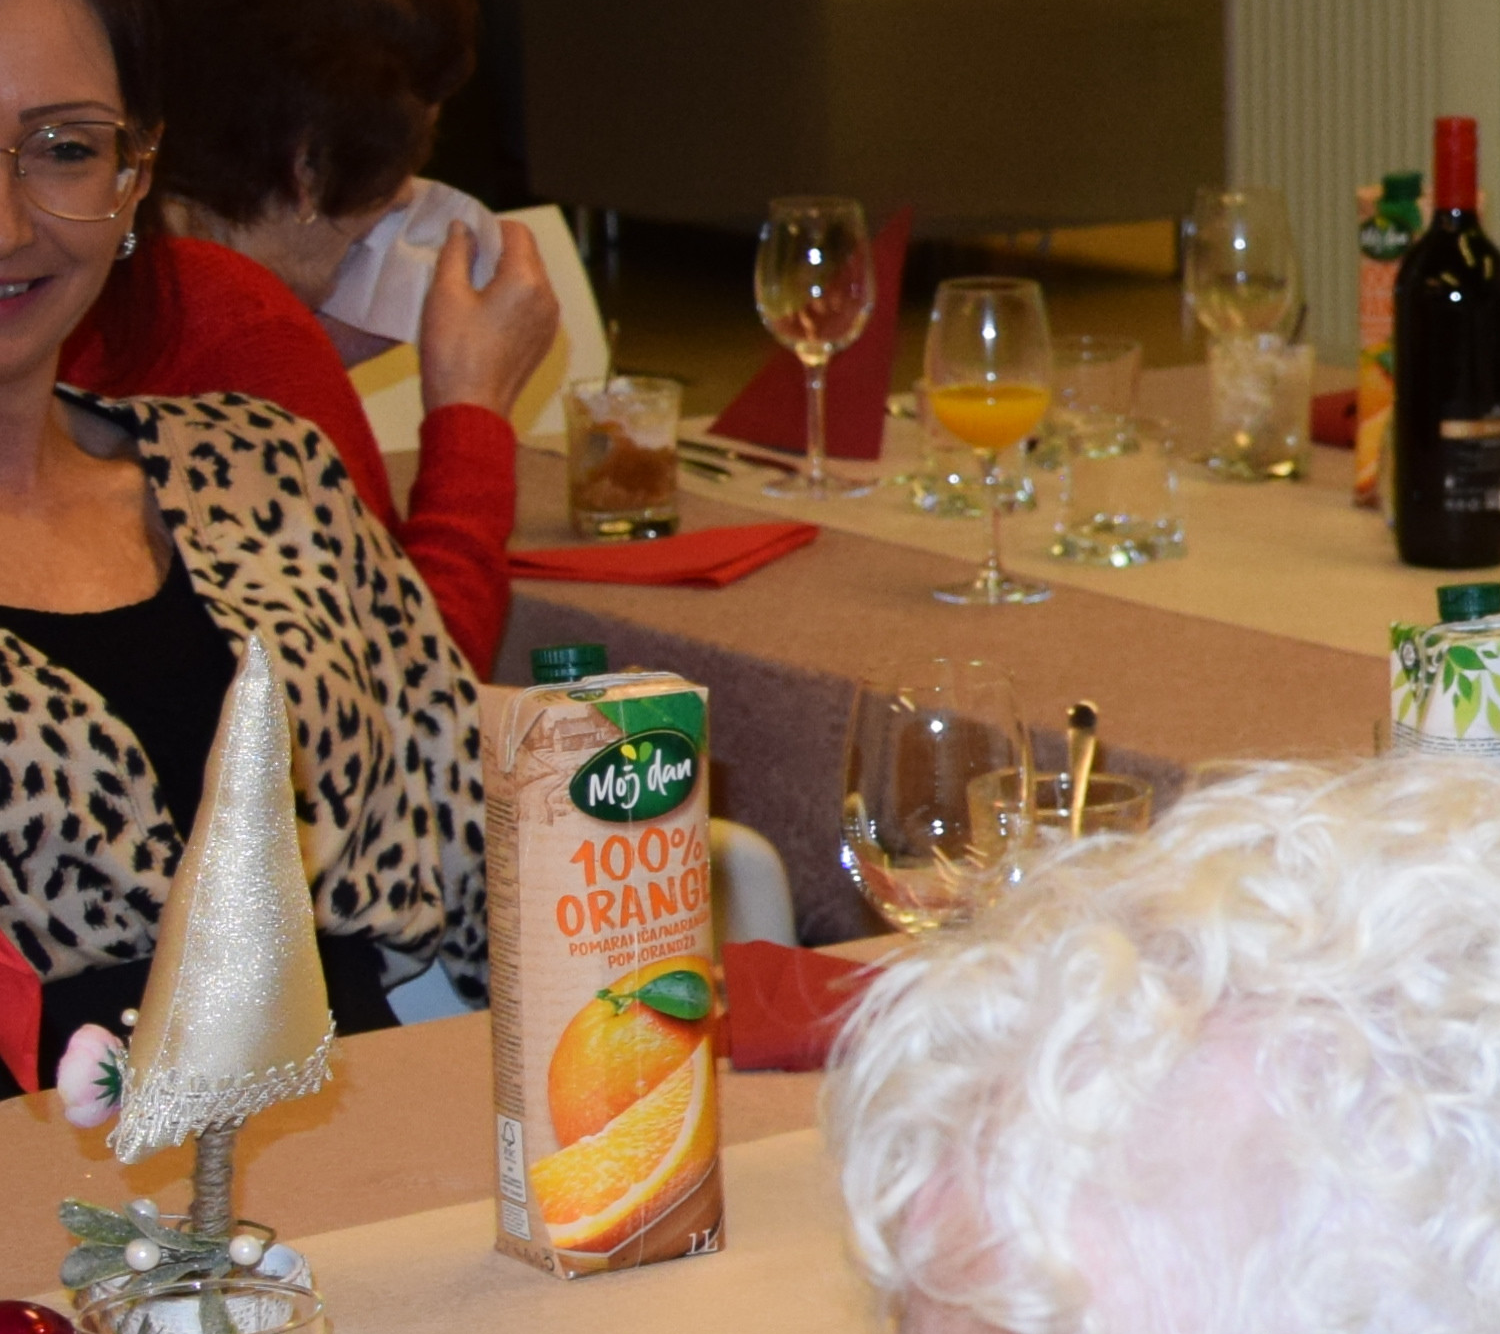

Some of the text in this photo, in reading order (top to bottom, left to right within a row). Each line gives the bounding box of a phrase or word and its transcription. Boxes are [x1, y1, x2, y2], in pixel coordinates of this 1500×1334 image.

[589, 748, 692, 809] Moj dan
[569, 824, 704, 887] 100%
[685, 1228, 719, 1257] 1L
